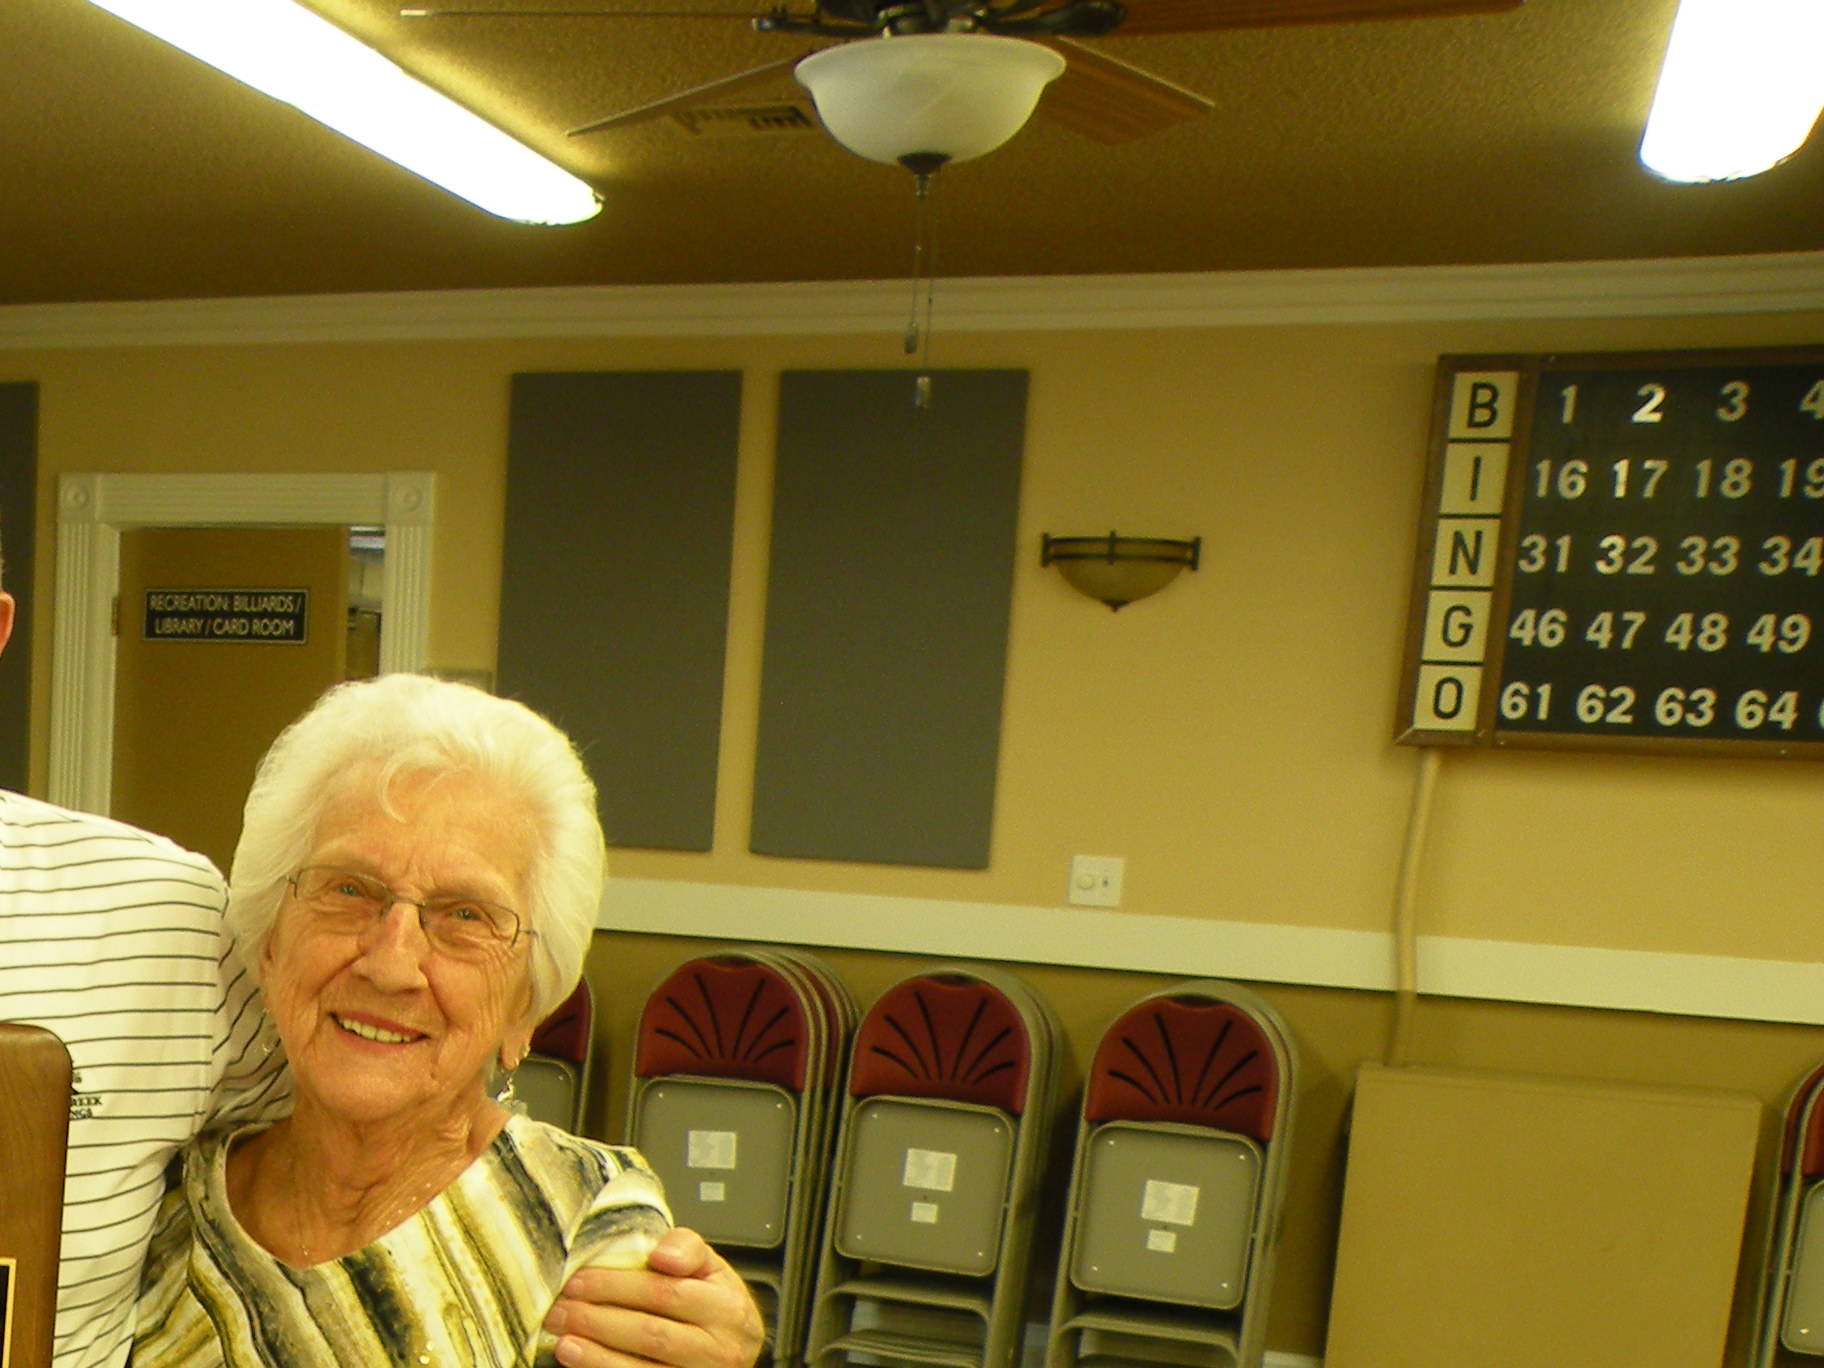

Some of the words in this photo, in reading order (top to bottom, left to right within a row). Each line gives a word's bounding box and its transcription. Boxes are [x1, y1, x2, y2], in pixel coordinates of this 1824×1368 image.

[1560, 384, 1578, 424] 1
[1631, 383, 1667, 423] 2
[1716, 380, 1750, 421] 3
[1535, 459, 1588, 498] 16
[1612, 458, 1668, 498] 17
[1696, 458, 1753, 498] 18
[1518, 534, 1572, 573] 31
[1595, 534, 1659, 574] 32
[1676, 536, 1741, 575] 33
[1759, 536, 1824, 576] 34
[233, 596, 294, 612] BILLIARDS
[155, 618, 204, 634] LIBRARY
[212, 619, 249, 635] CARD
[252, 619, 294, 636] ROOM
[1508, 608, 1567, 648] 46
[1586, 611, 1646, 649] 47
[1665, 612, 1729, 652] 48
[1747, 613, 1811, 654] 49
[1500, 681, 1552, 721] 61
[1576, 684, 1636, 724] 62
[1654, 687, 1717, 726] 63
[1734, 690, 1799, 730] 64
